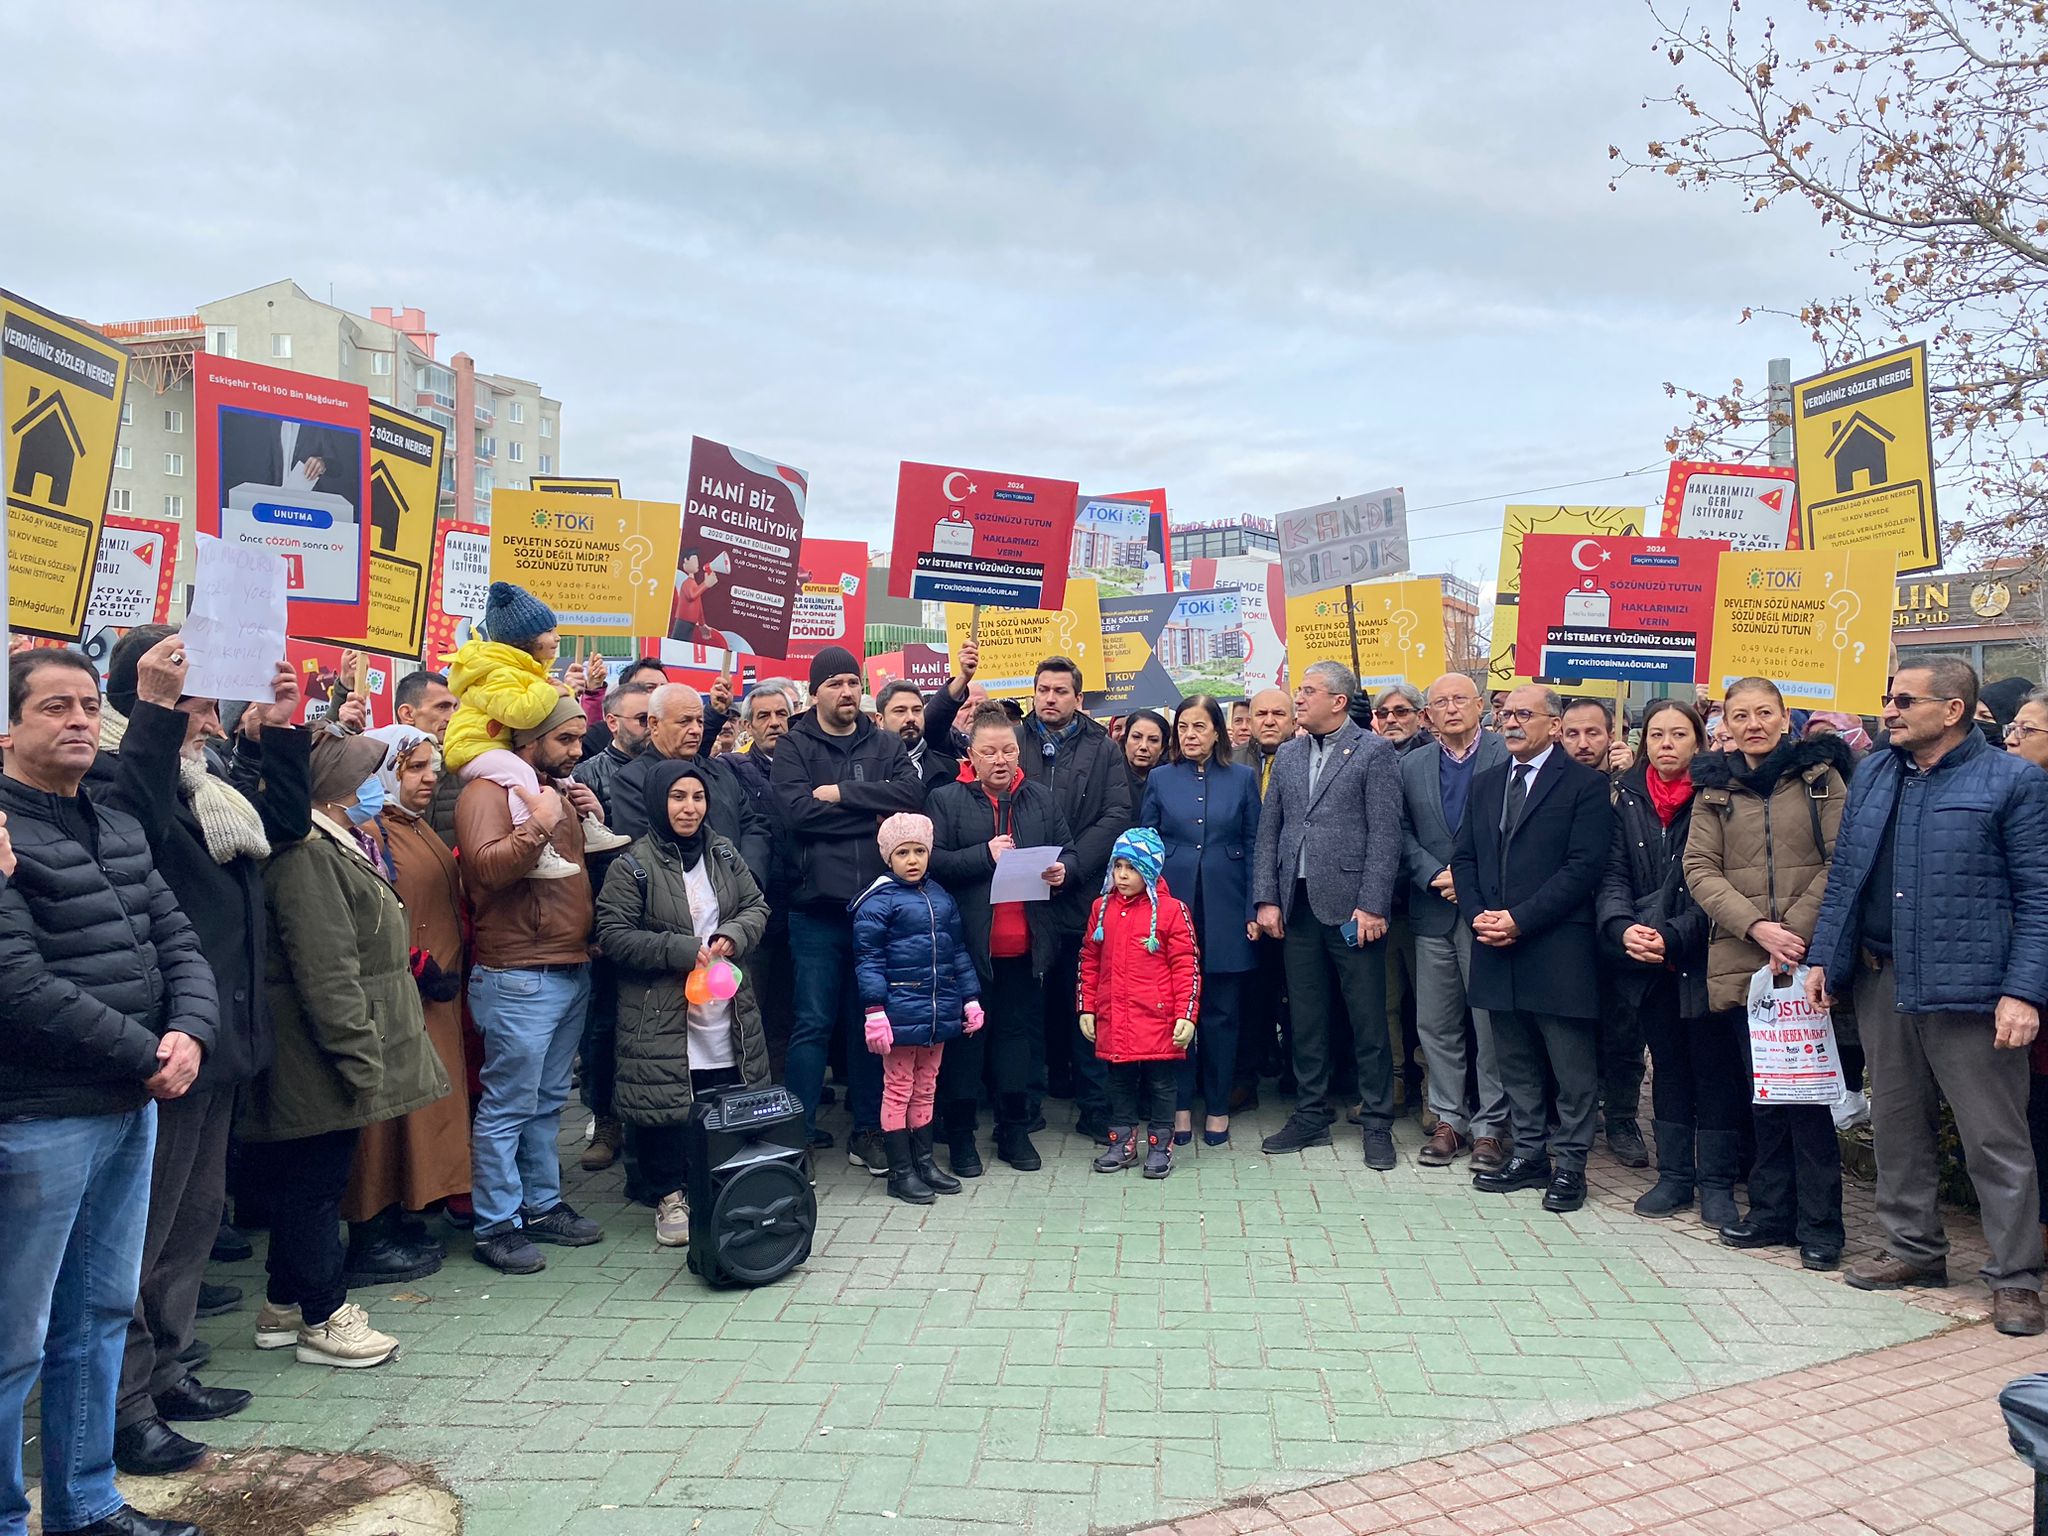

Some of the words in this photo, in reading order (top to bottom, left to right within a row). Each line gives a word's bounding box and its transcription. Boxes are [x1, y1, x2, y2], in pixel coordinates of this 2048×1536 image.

[4, 326, 54, 361] VERDİĞİNİZ
[54, 347, 86, 375] SÖZLER
[86, 362, 115, 388] NEREDE
[209, 374, 250, 388] Eskişehir
[273, 386, 288, 396] 100
[290, 390, 304, 399] Bin
[306, 392, 349, 408] Mağdurları
[1804, 386, 1846, 410] VERDİĞİNİZ
[1847, 380, 1878, 396] SÖZLER
[1878, 368, 1912, 388] NEREDE
[376, 427, 404, 448] SÖZLER
[404, 438, 432, 458] NEREDE
[1008, 482, 1024, 490] 2024
[1688, 483, 1754, 498] HAKLARIMIZI
[700, 476, 744, 504] HANİ
[749, 488, 776, 513] BİZ
[1708, 496, 1731, 507] GERİ
[1872, 494, 1888, 504] VADE
[1890, 488, 1916, 498] NEREDE
[274, 510, 313, 521] UNUTMA
[1692, 505, 1744, 520] İSTİYORUZ
[22, 514, 33, 524] 240
[45, 520, 62, 532] VADE
[62, 525, 87, 538] NEREDE
[688, 500, 718, 520] DAR
[721, 510, 798, 542] GELİRLİYDİK
[974, 512, 1022, 525] SÖZÜNÜZÜ
[1024, 519, 1052, 528] TUTUN
[1856, 523, 1883, 534] VERİLEN
[1884, 516, 1916, 528] SÖZLERİN
[17, 531, 31, 541] KDV
[32, 535, 58, 548] NEREDE
[240, 532, 263, 544] Önce
[302, 541, 328, 550] sonra
[734, 535, 750, 546] VAAT
[982, 534, 1040, 547] HAKLARIMIZI
[1718, 531, 1748, 539] KDV
[1831, 534, 1872, 548] TUTULMASINI
[1872, 528, 1906, 540] İSTİYORUZ
[447, 540, 488, 554] HAKLARIM
[554, 538, 583, 550] SÖZÜ
[584, 540, 620, 552] NAMUS
[464, 552, 481, 564] GERİ
[514, 546, 543, 558] SÖZÜ
[546, 548, 573, 560] DEĞİL
[20, 553, 46, 567] VERİLEN
[48, 560, 77, 573] SÖZLERİN
[378, 562, 393, 572] VADE
[452, 560, 488, 574] İSTİYORU
[516, 558, 574, 571] SÖZÜNÜZÜ
[576, 564, 608, 573] TUTUN
[918, 558, 931, 566] OY
[932, 558, 973, 570] İSTEMEYE
[974, 562, 1014, 574] YÜZÜNÜZ
[1016, 566, 1043, 577] OLSUN
[1633, 556, 1652, 565] Seçim
[33, 568, 65, 583] İSTİYORUZ
[585, 582, 610, 590] Farkı
[1610, 580, 1666, 590] SÖZÜNÜZÜ
[1668, 584, 1702, 592] TUTUN
[542, 592, 554, 600] Ay
[558, 592, 586, 600] Sabit
[588, 592, 623, 601] Ödeme
[1764, 596, 1789, 608] SÖZÜ
[1791, 600, 1826, 610] NAMUS
[1894, 582, 1950, 612] LIN
[99, 610, 131, 618] OLDU
[1621, 602, 1688, 613] HAKLARIMIZI
[996, 617, 1019, 627] SÖZÜ
[1020, 617, 1050, 626] NAMUS
[1118, 615, 1149, 624] SÖZLER
[1638, 616, 1670, 626] VERİN
[1732, 608, 1754, 621] SÖZÜ
[1756, 611, 1780, 622] DEĞİL
[1782, 612, 1814, 623] MİDİR?
[1914, 610, 1950, 624] Pub
[792, 624, 835, 636] DÖNDÜ
[1358, 618, 1388, 628] NAMUS
[1732, 622, 1779, 634] SÖZÜNÜZÜ
[1782, 625, 1812, 636] TUTUN
[1016, 636, 1042, 644] TUTUN
[1304, 631, 1326, 640] SÖZÜ
[1547, 632, 1563, 640] OY
[1564, 630, 1612, 642] İSTEMEYE
[1613, 632, 1660, 644] YÜZÜNÜZ
[1662, 636, 1696, 646] OLSUN
[1306, 640, 1350, 649] SÖZÜNÜZÜ
[1763, 646, 1784, 654] Vade
[1788, 646, 1814, 656] Farkı
[912, 660, 940, 674] HANİ
[992, 662, 1001, 670] Ay
[1004, 660, 1026, 668] Sabit
[1732, 656, 1747, 664] 240
[1750, 657, 1761, 666] Ay
[1764, 658, 1787, 666] Sabit
[1791, 660, 1825, 668] Ödeme
[1115, 672, 1136, 681] KDV
[1771, 670, 1791, 678] KDV
[1782, 1029, 1802, 1042] BEBEK
